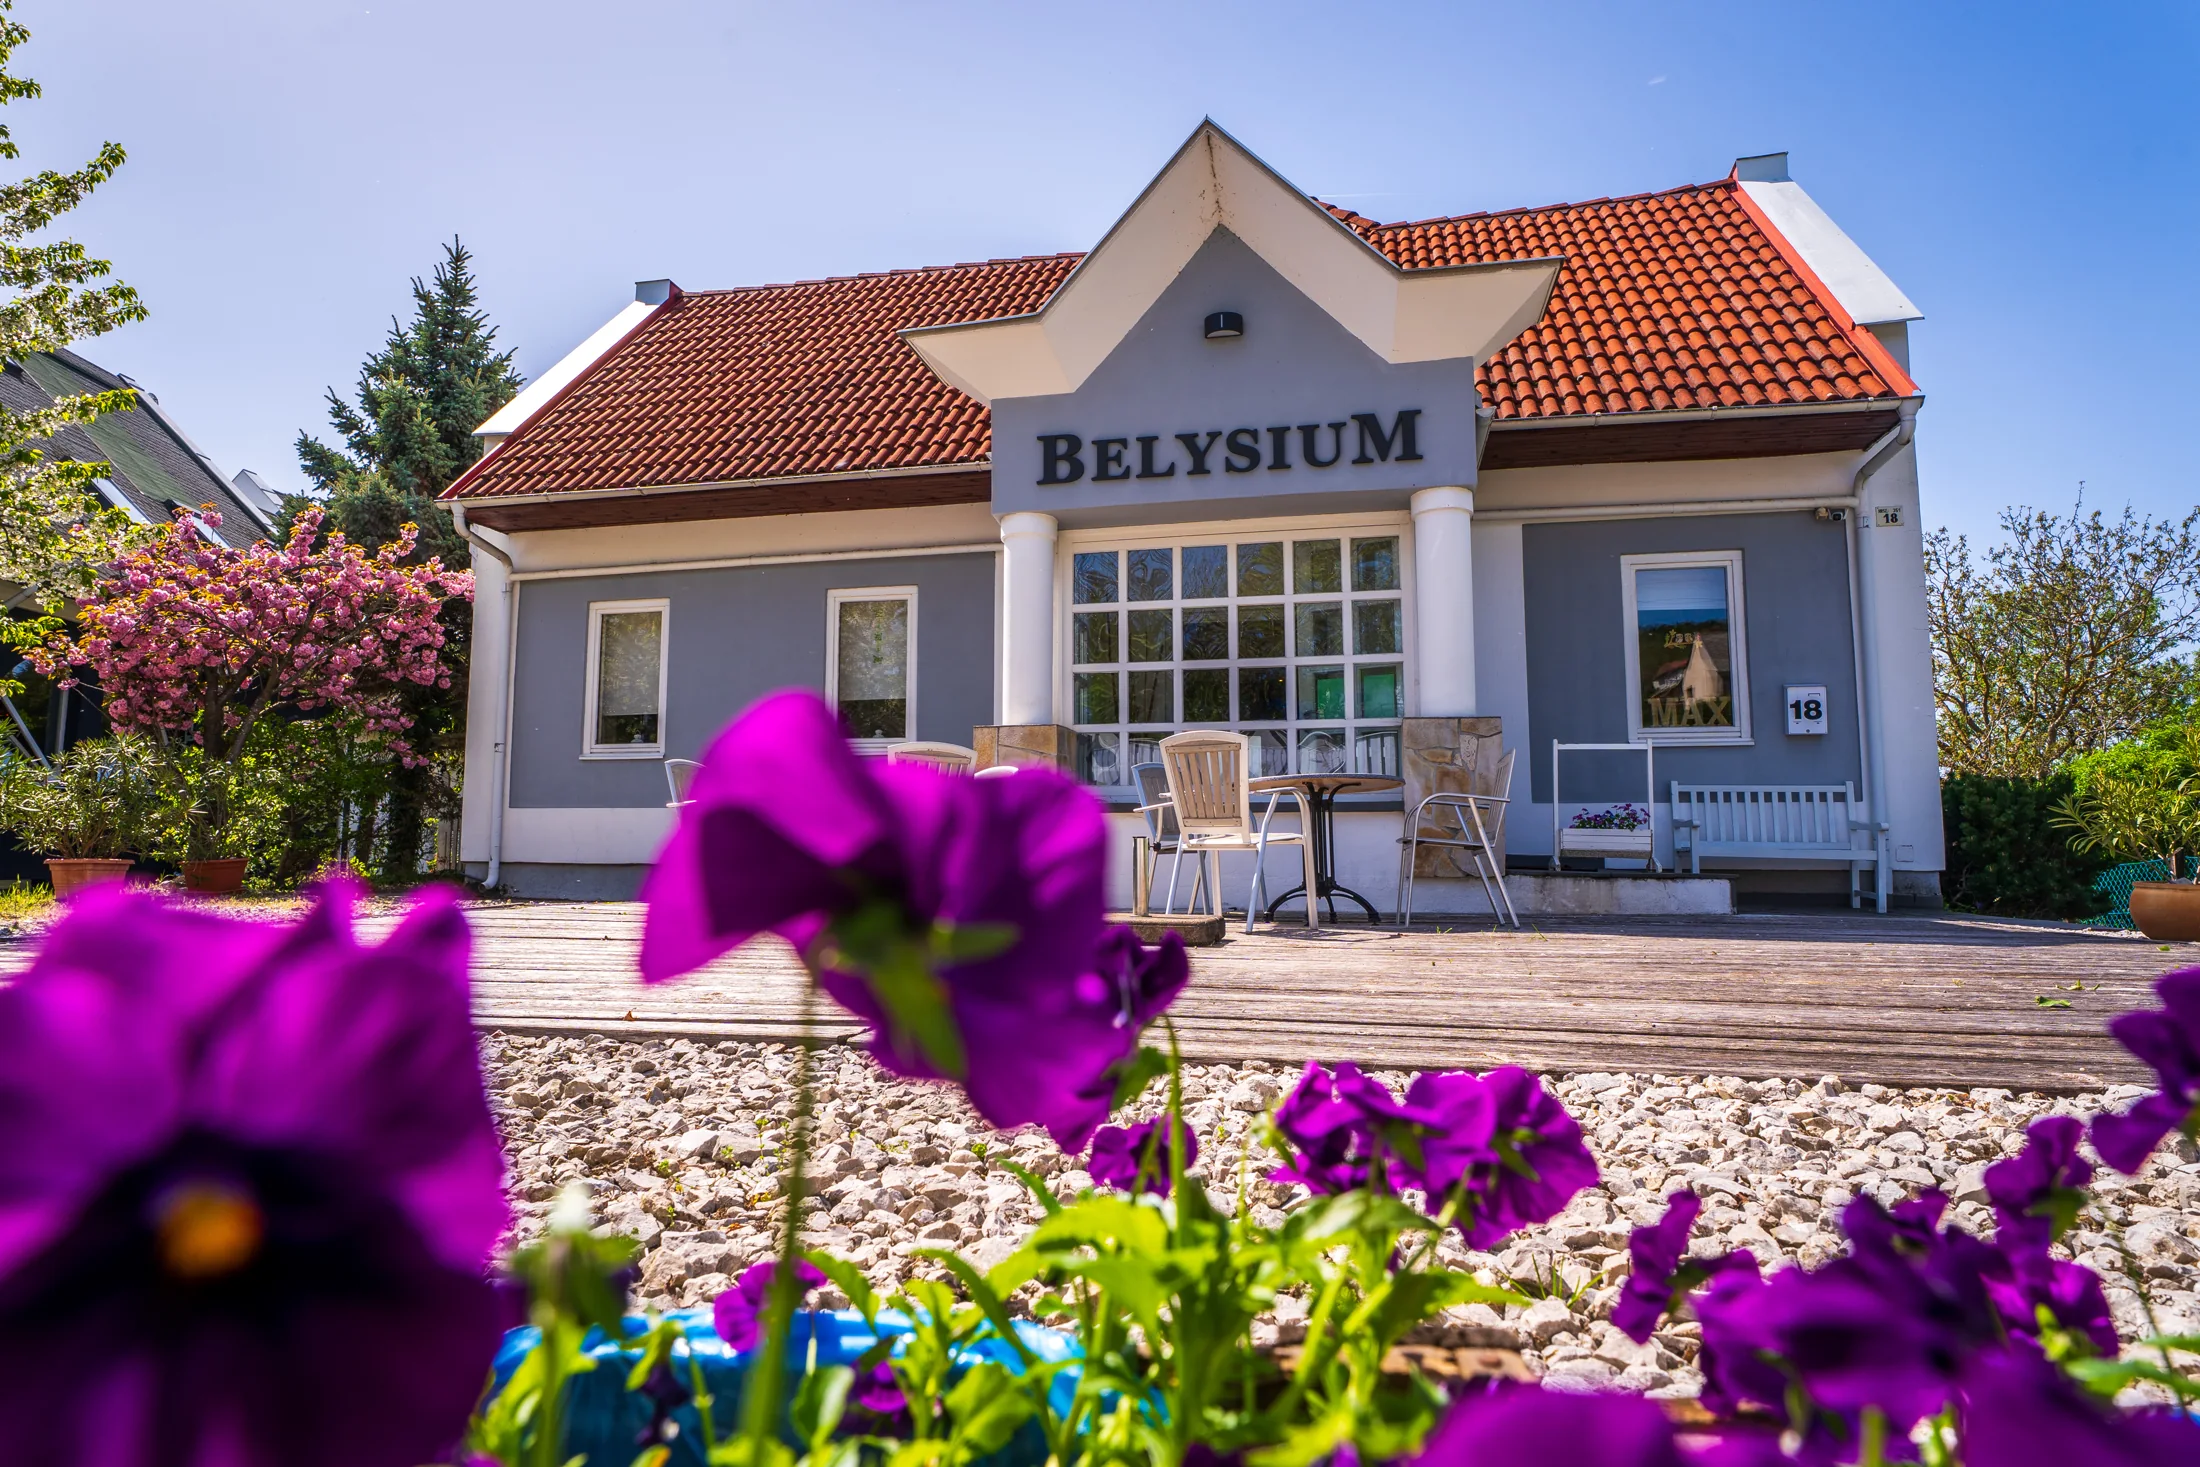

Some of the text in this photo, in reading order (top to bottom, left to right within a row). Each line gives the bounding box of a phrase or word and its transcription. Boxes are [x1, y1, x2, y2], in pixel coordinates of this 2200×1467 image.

[1036, 409, 1424, 486] BELYSIUM
[1883, 512, 1899, 524] 18
[1647, 696, 1732, 727] MAX
[1789, 699, 1823, 721] 18
